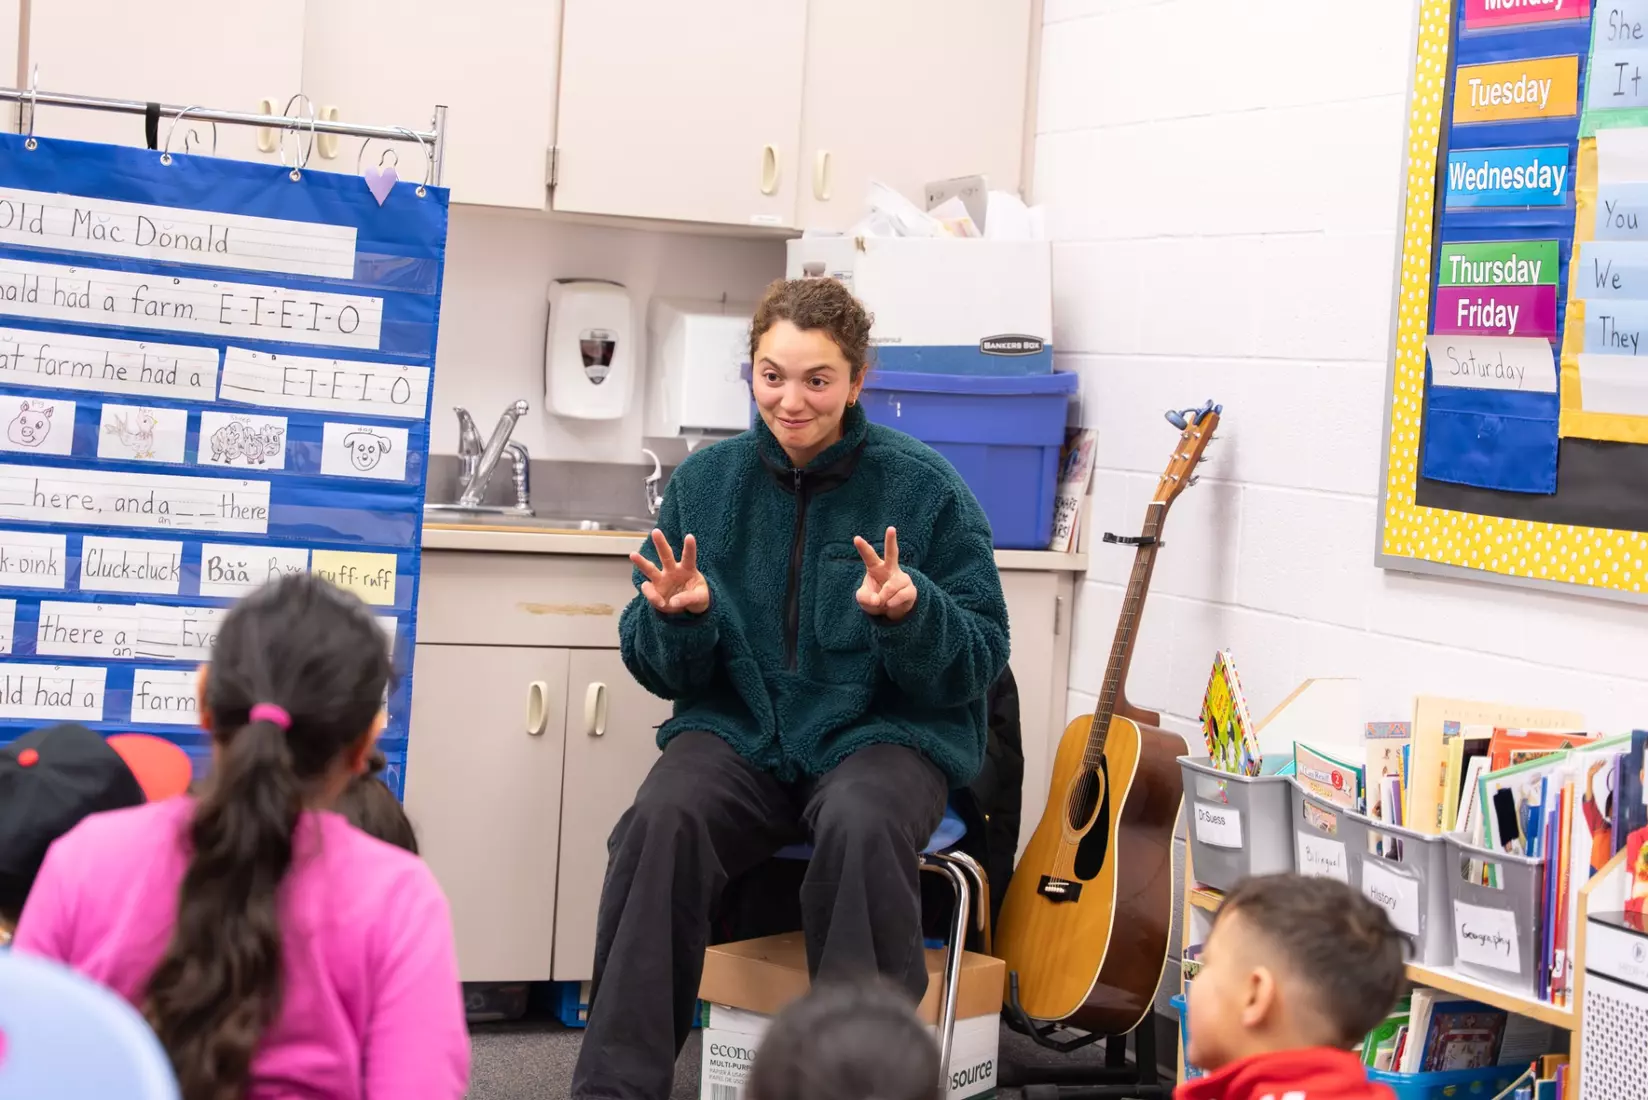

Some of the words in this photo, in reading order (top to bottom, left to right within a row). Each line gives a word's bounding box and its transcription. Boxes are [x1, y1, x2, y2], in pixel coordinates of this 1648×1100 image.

[1607, 10, 1644, 41] She
[1468, 74, 1552, 109] Tuesday
[1613, 62, 1642, 97] It
[1449, 158, 1566, 195] Wednesday
[1605, 200, 1638, 229] You
[1448, 253, 1541, 285] Thursday
[1594, 258, 1622, 290] We
[103, 296, 115, 312] a
[132, 284, 198, 321] farm.
[1457, 298, 1520, 335] Friday
[1600, 315, 1640, 355] They
[34, 344, 93, 379] farm
[102, 351, 127, 381] he
[190, 372, 202, 387] a
[1446, 346, 1525, 388] Saturday
[33, 478, 103, 514] here,
[218, 493, 268, 521] there
[86, 548, 181, 582] Cluck-cluck
[40, 614, 104, 644] there
[114, 630, 126, 646] a
[112, 646, 132, 657] an
[34, 676, 75, 706] had
[83, 692, 94, 708] a
[1370, 885, 1397, 910] History
[1461, 922, 1511, 957] Geography
[947, 1059, 993, 1090] source
